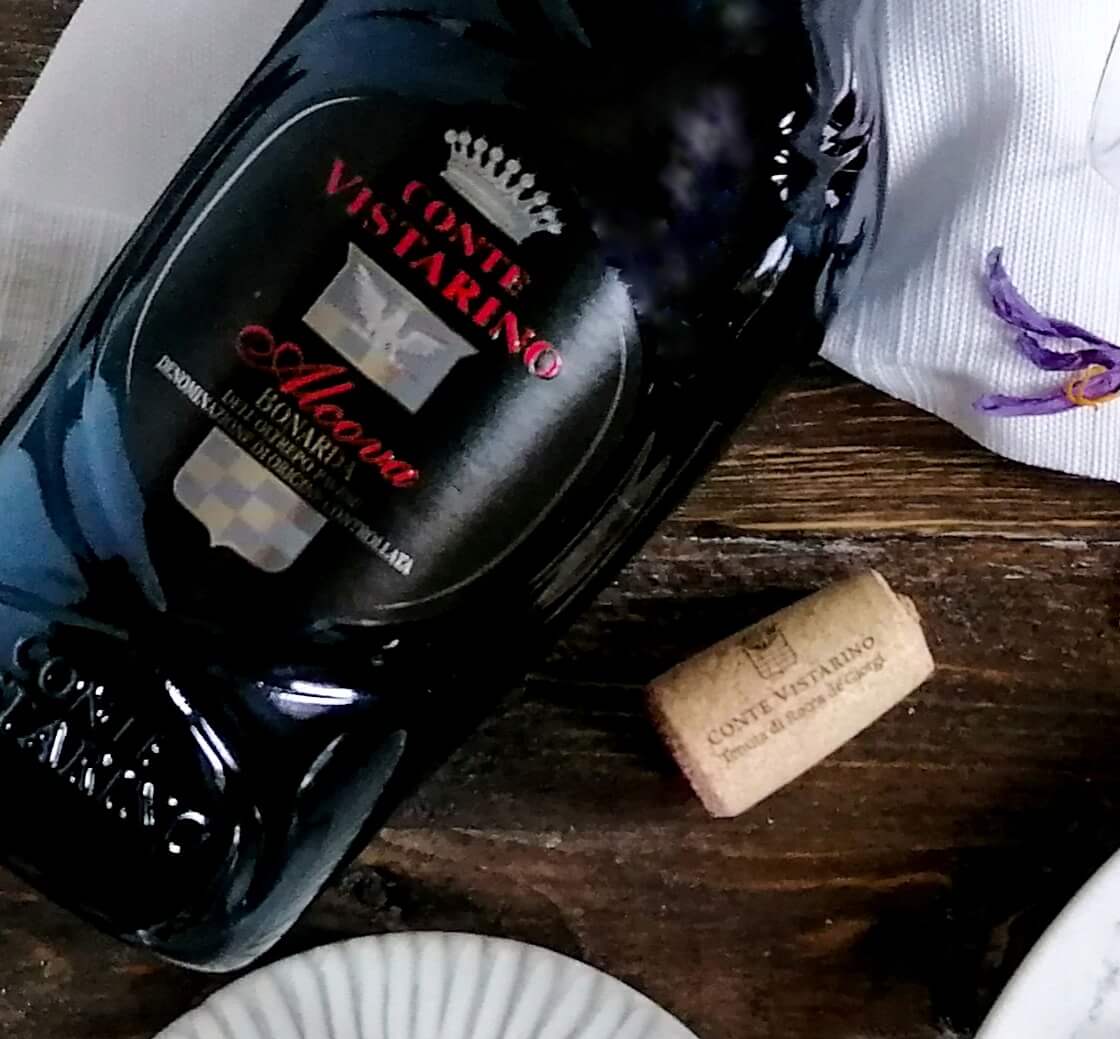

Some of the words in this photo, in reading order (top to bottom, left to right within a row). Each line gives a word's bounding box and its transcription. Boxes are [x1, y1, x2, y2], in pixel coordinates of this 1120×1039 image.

[325, 158, 563, 380] VISTARINO
[402, 180, 531, 296] CONTE
[237, 324, 421, 488] Alcova
[256, 387, 356, 481] BONARDA
[706, 699, 773, 746] CONTE
[773, 635, 875, 702] VISTARINO
[768, 717, 786, 735] di
